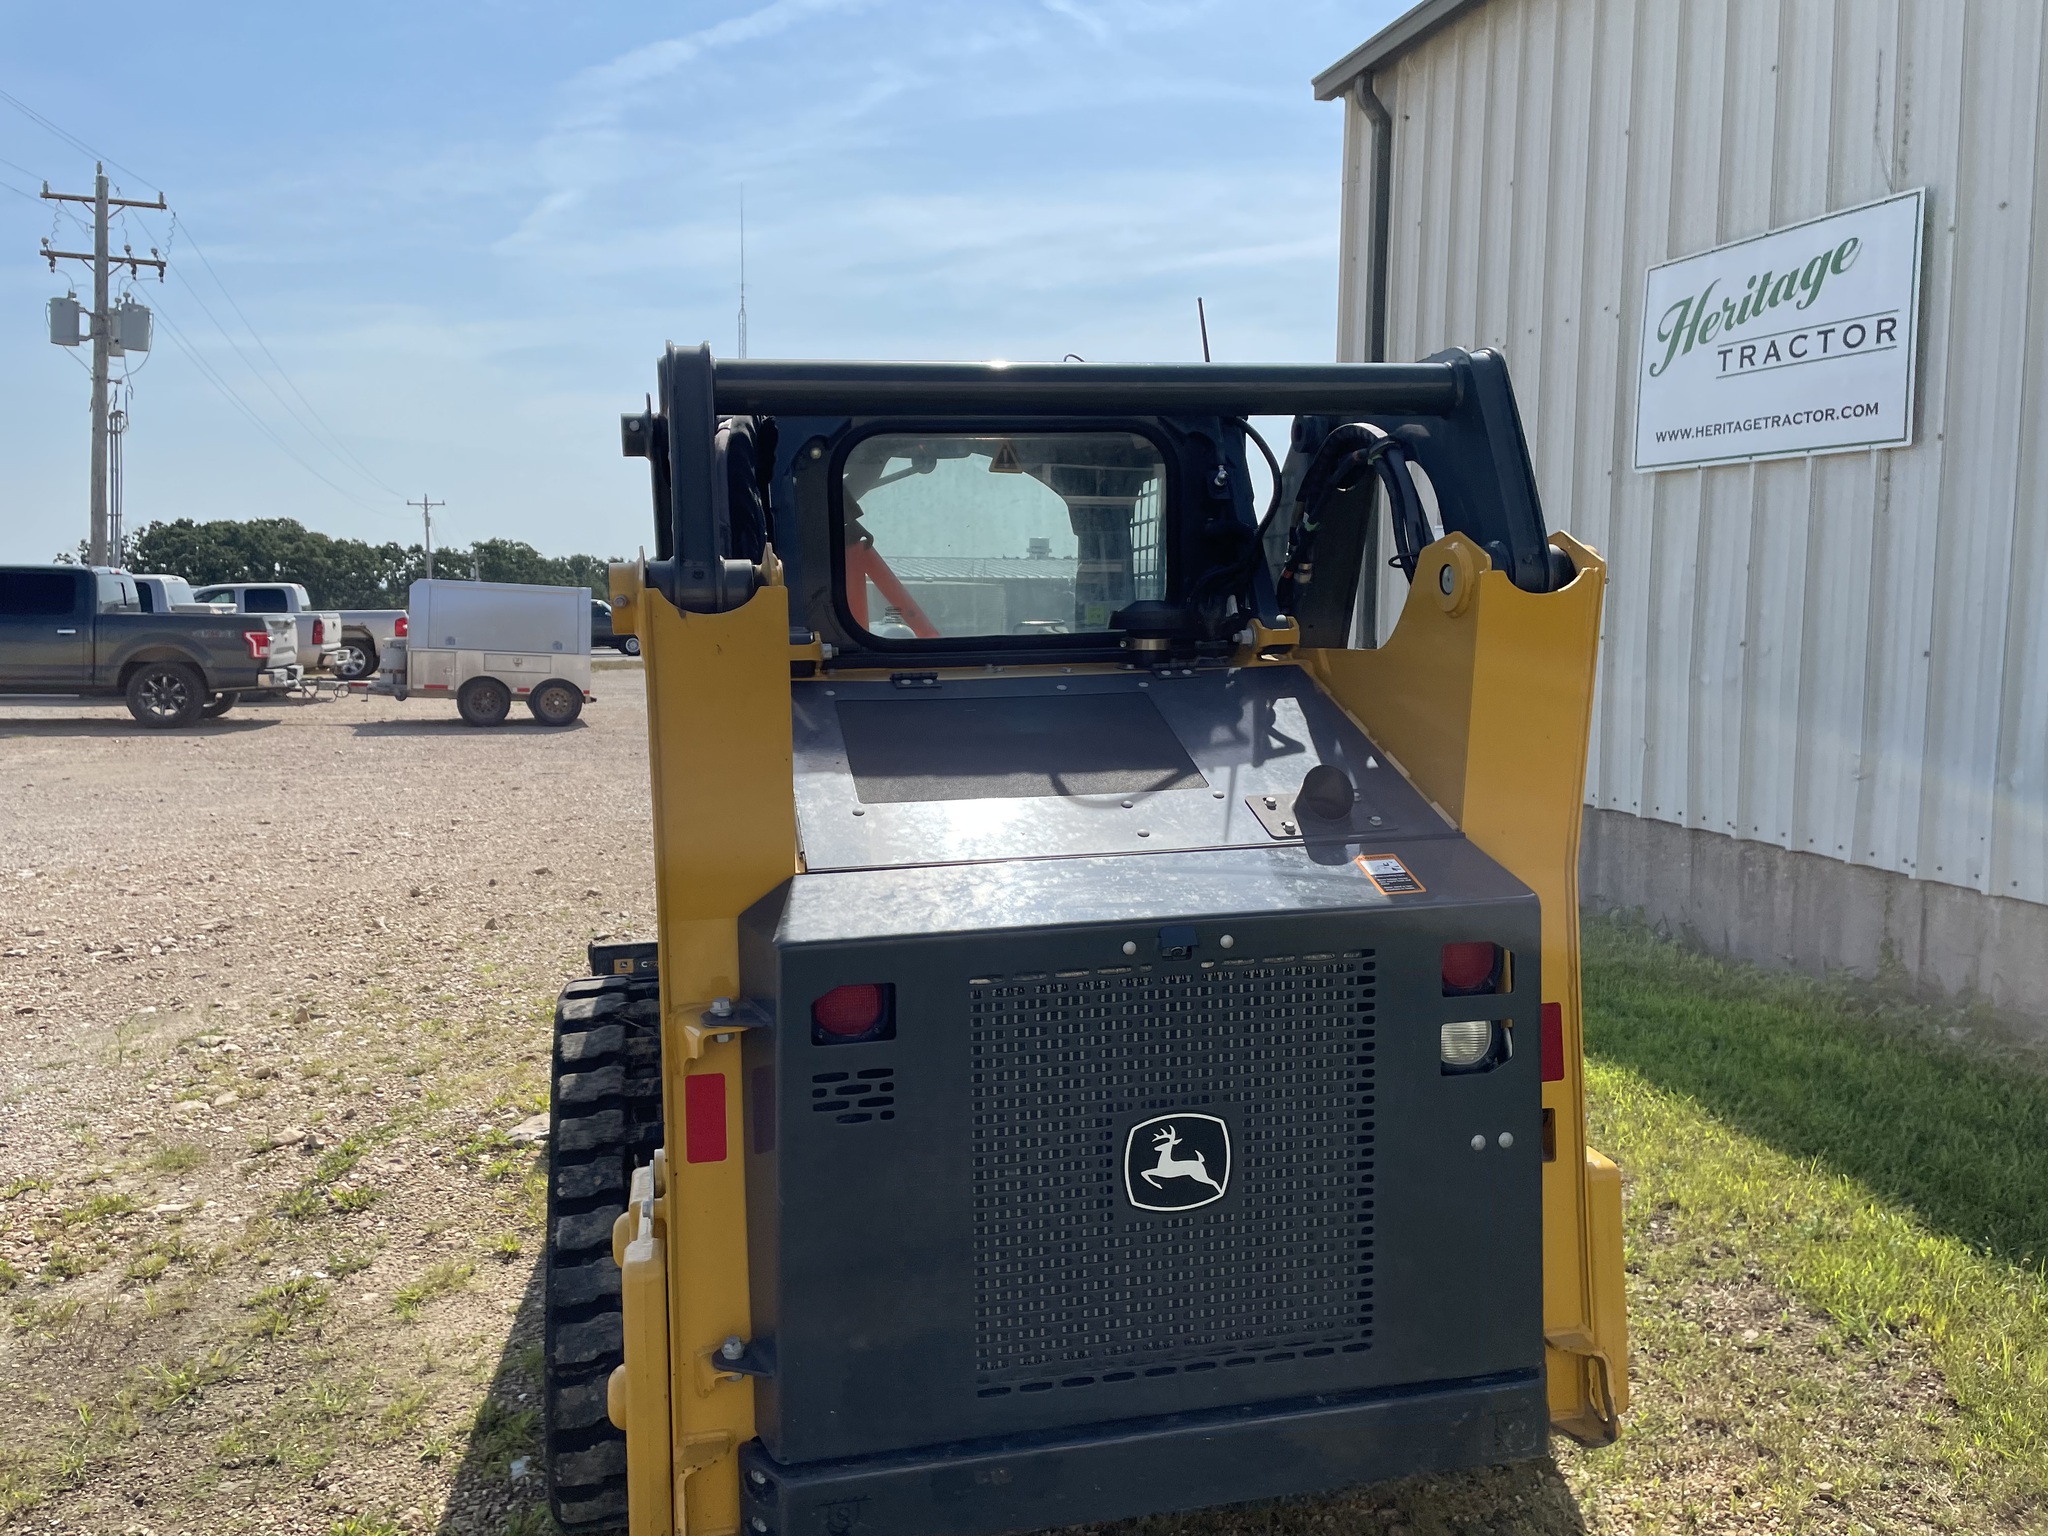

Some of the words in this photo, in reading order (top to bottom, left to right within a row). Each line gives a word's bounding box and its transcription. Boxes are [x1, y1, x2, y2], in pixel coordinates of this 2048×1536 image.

[1649, 237, 1863, 377] Heritage
[1717, 317, 1897, 372] TRACTOR
[1655, 402, 1880, 443] WWW.HERITAGETRACTOR.COM
